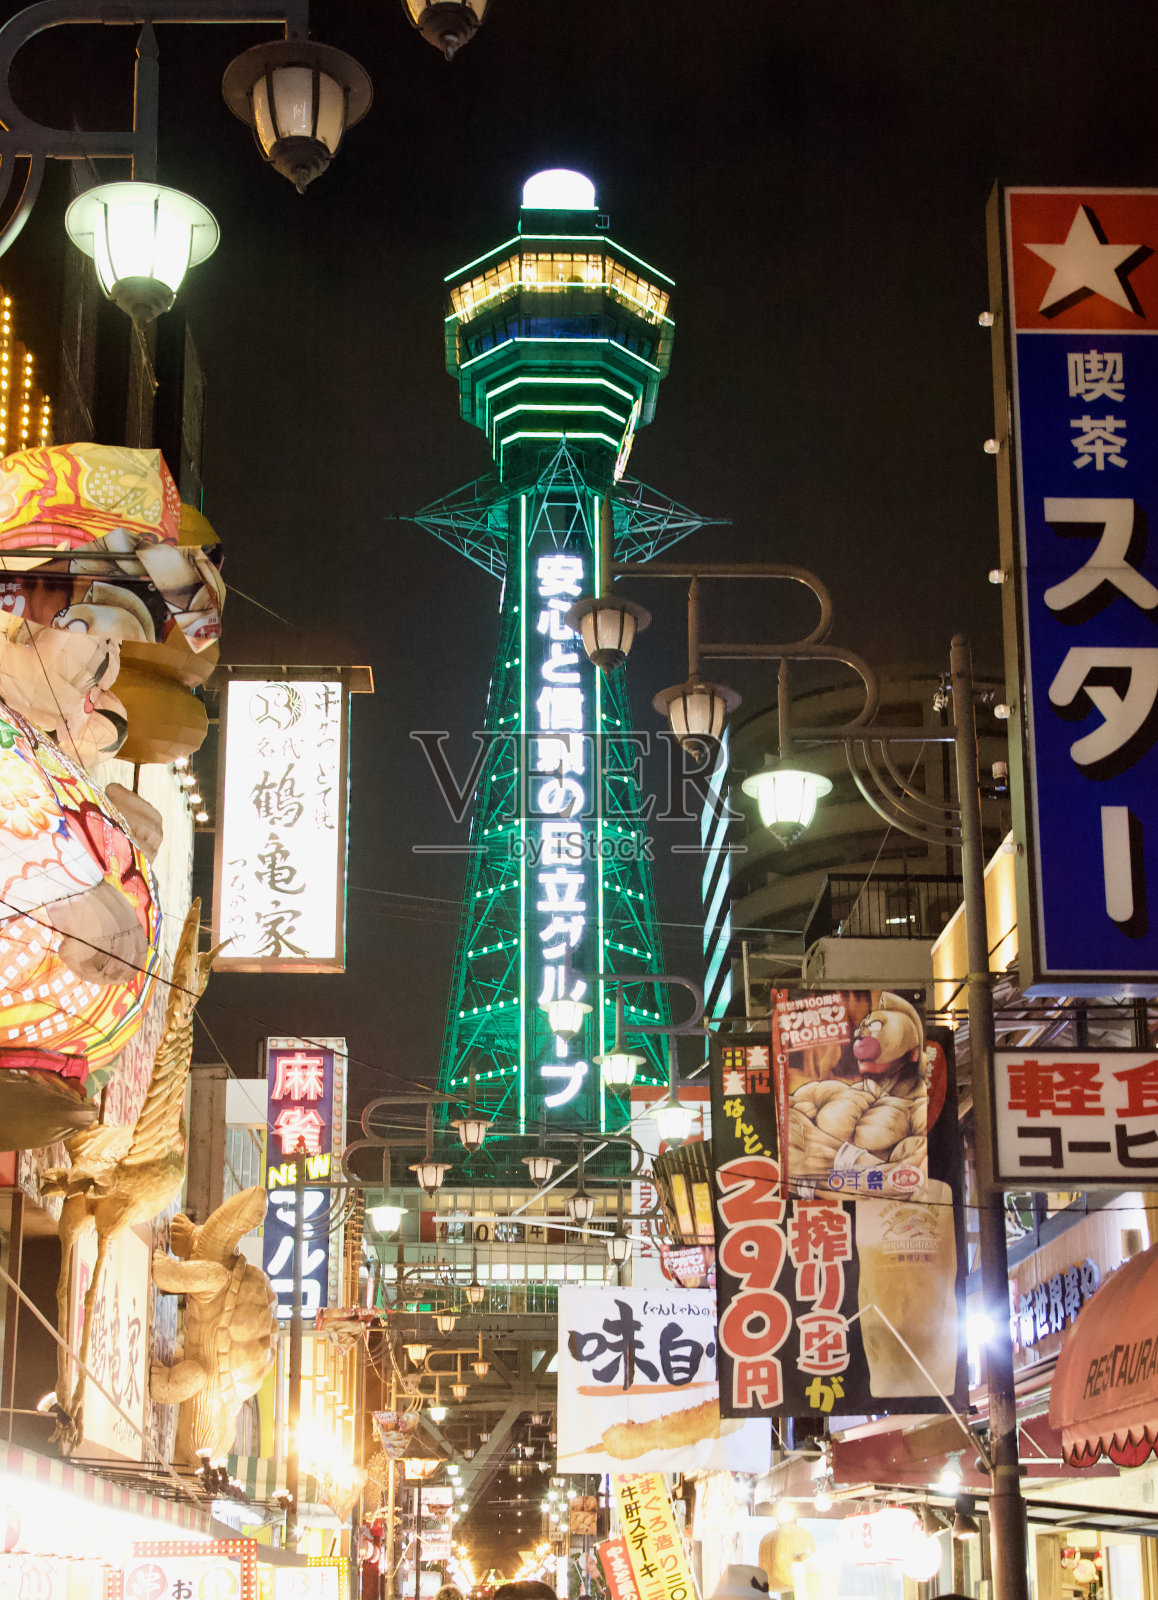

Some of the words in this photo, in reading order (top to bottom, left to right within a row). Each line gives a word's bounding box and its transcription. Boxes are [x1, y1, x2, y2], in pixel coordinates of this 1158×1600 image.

[1066, 351, 1129, 472] 喫茶
[1043, 497, 1158, 923] スター
[249, 763, 310, 959] 鶴亀家
[781, 1021, 848, 1046] PROJECT
[269, 1052, 326, 1155] 麻雀
[268, 1154, 331, 1190] NEW
[640, 1168, 653, 1258] SHINEKAI
[716, 1155, 793, 1409] 290円
[1083, 1335, 1158, 1400] RESTAURA
